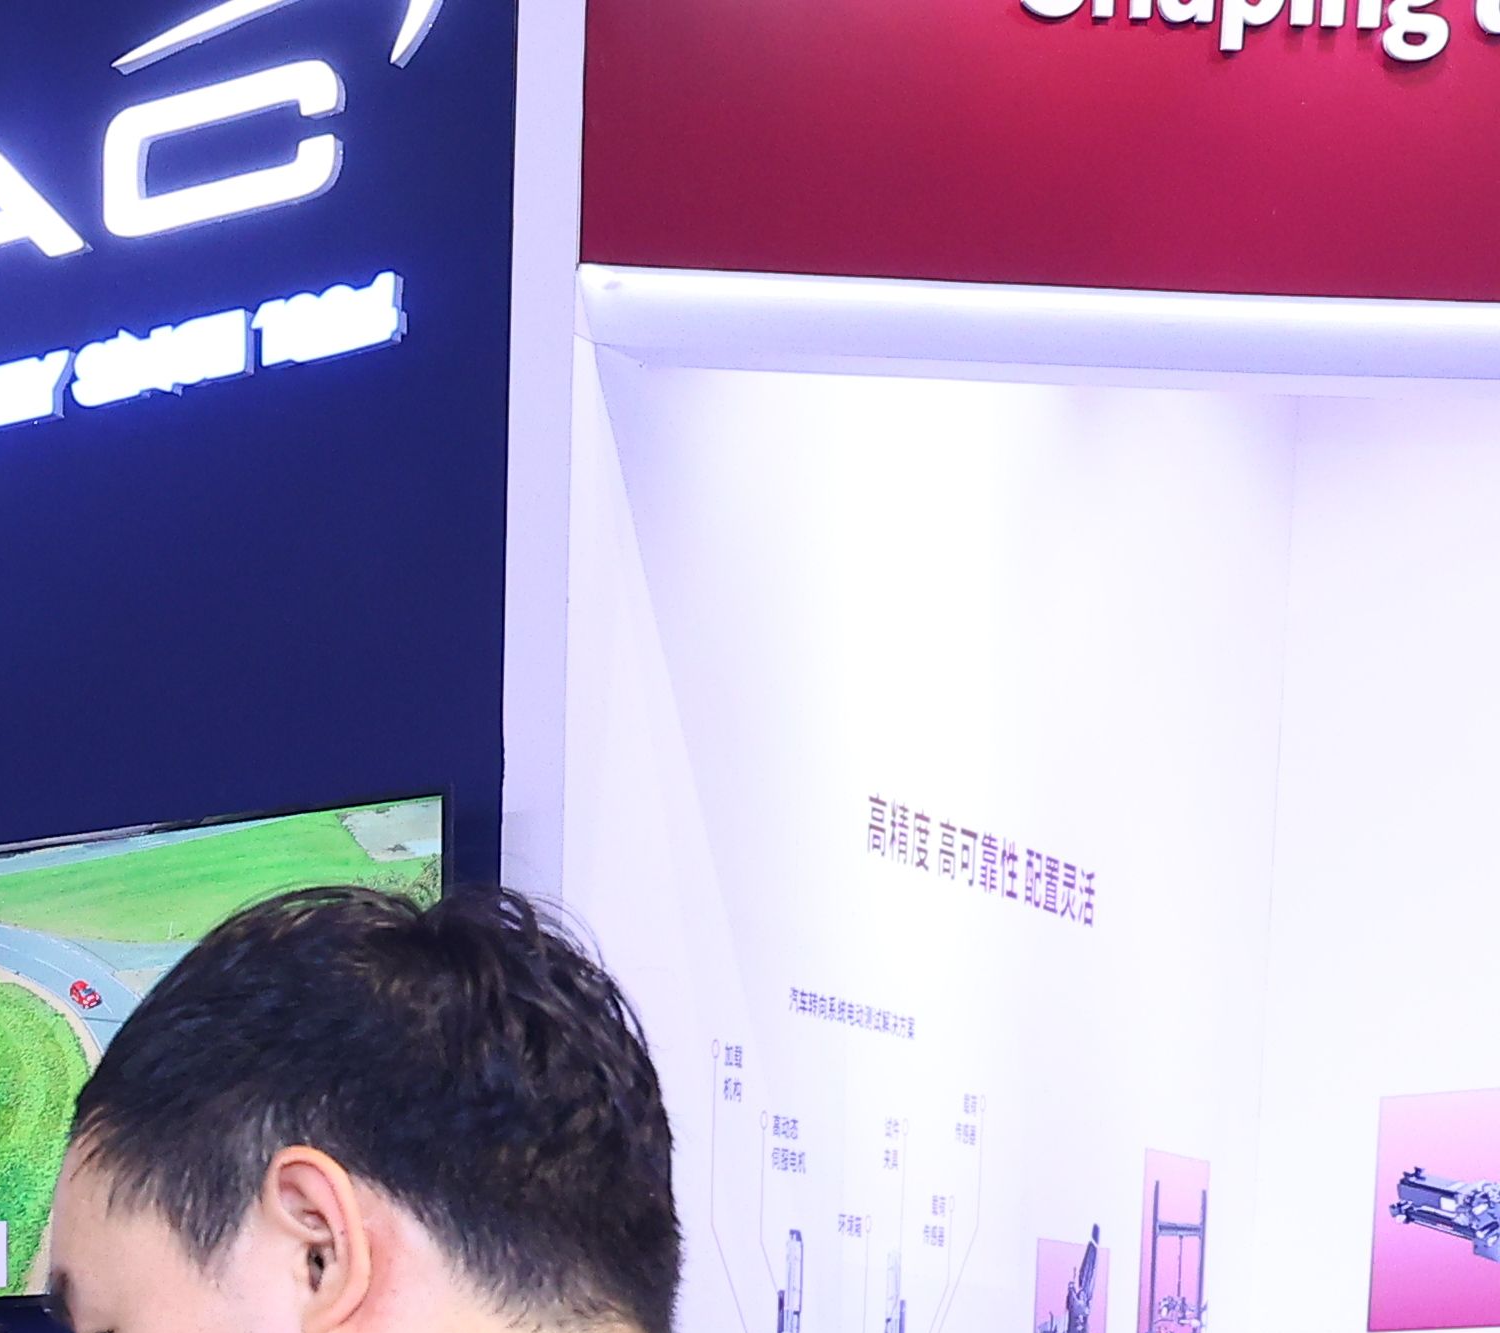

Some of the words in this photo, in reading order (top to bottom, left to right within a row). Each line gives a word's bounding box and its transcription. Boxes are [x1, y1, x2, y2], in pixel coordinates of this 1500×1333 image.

[867, 792, 931, 872] 高精度
[938, 817, 1018, 899] 高可靠性
[1024, 847, 1096, 928] 配置灵活
